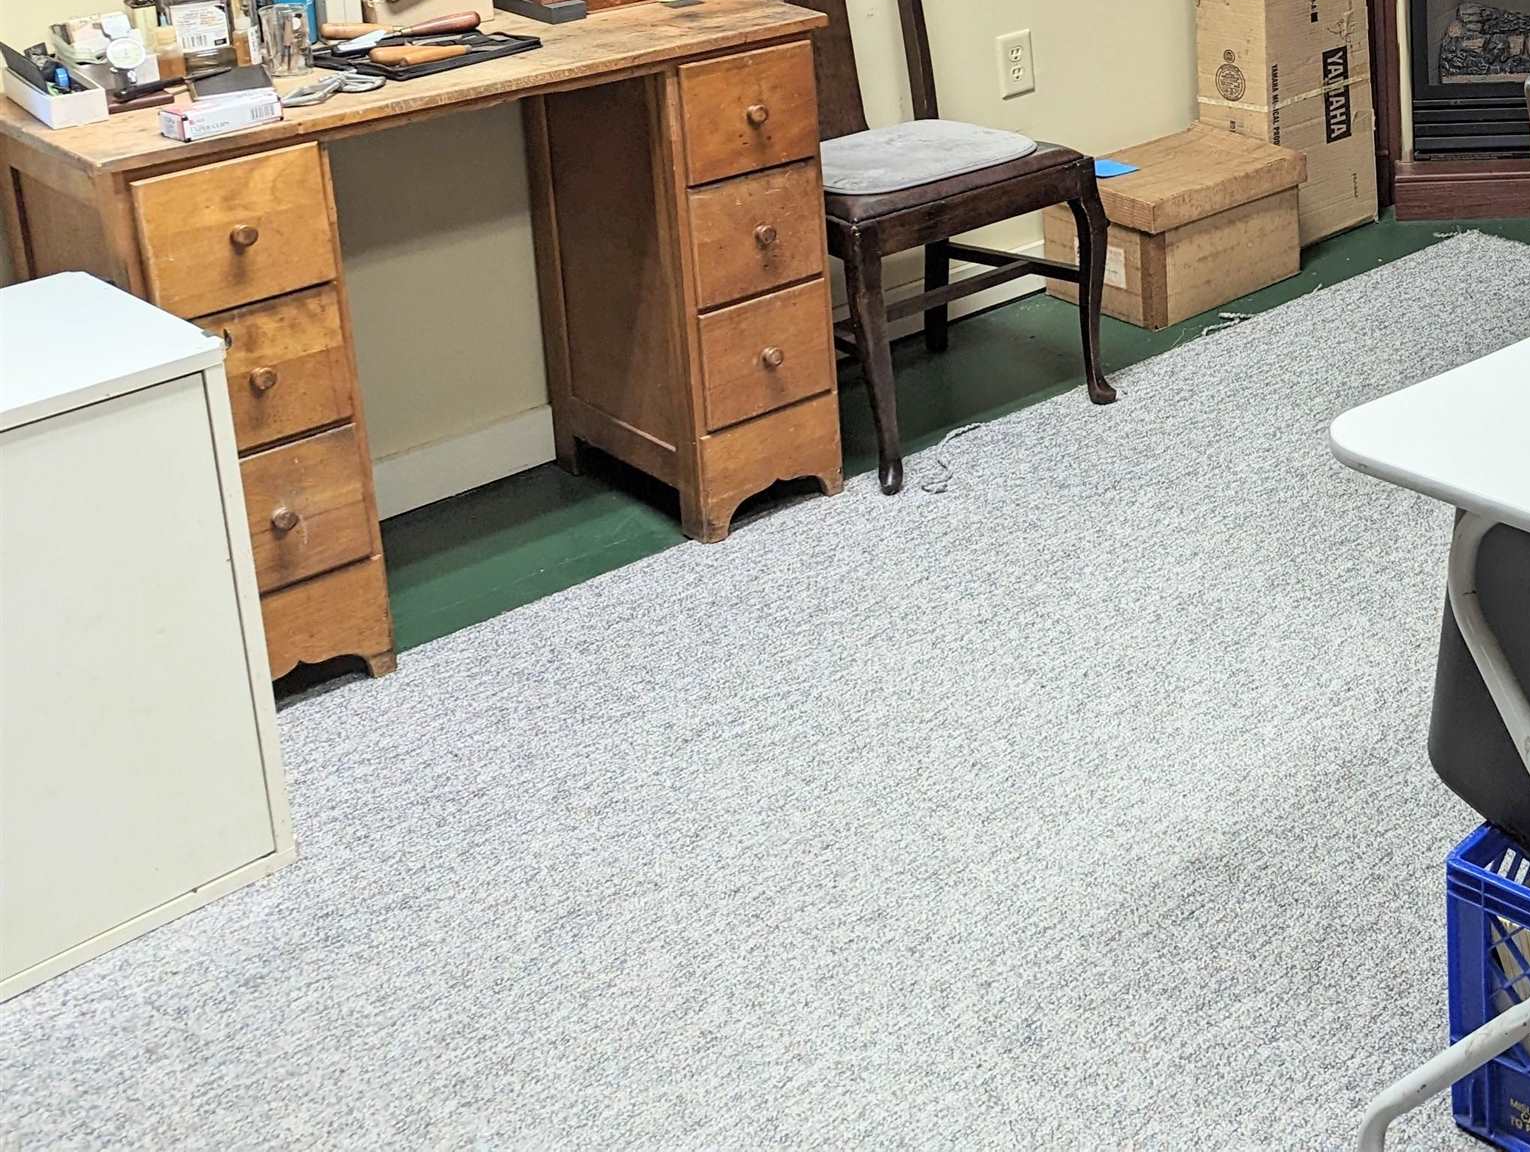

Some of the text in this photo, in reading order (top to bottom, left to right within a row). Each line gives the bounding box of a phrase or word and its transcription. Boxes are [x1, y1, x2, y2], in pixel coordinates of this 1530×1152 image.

[1271, 63, 1281, 93] YAMAHA
[1272, 94, 1281, 125] MUICAL
[1326, 49, 1348, 140] YAMAHA
